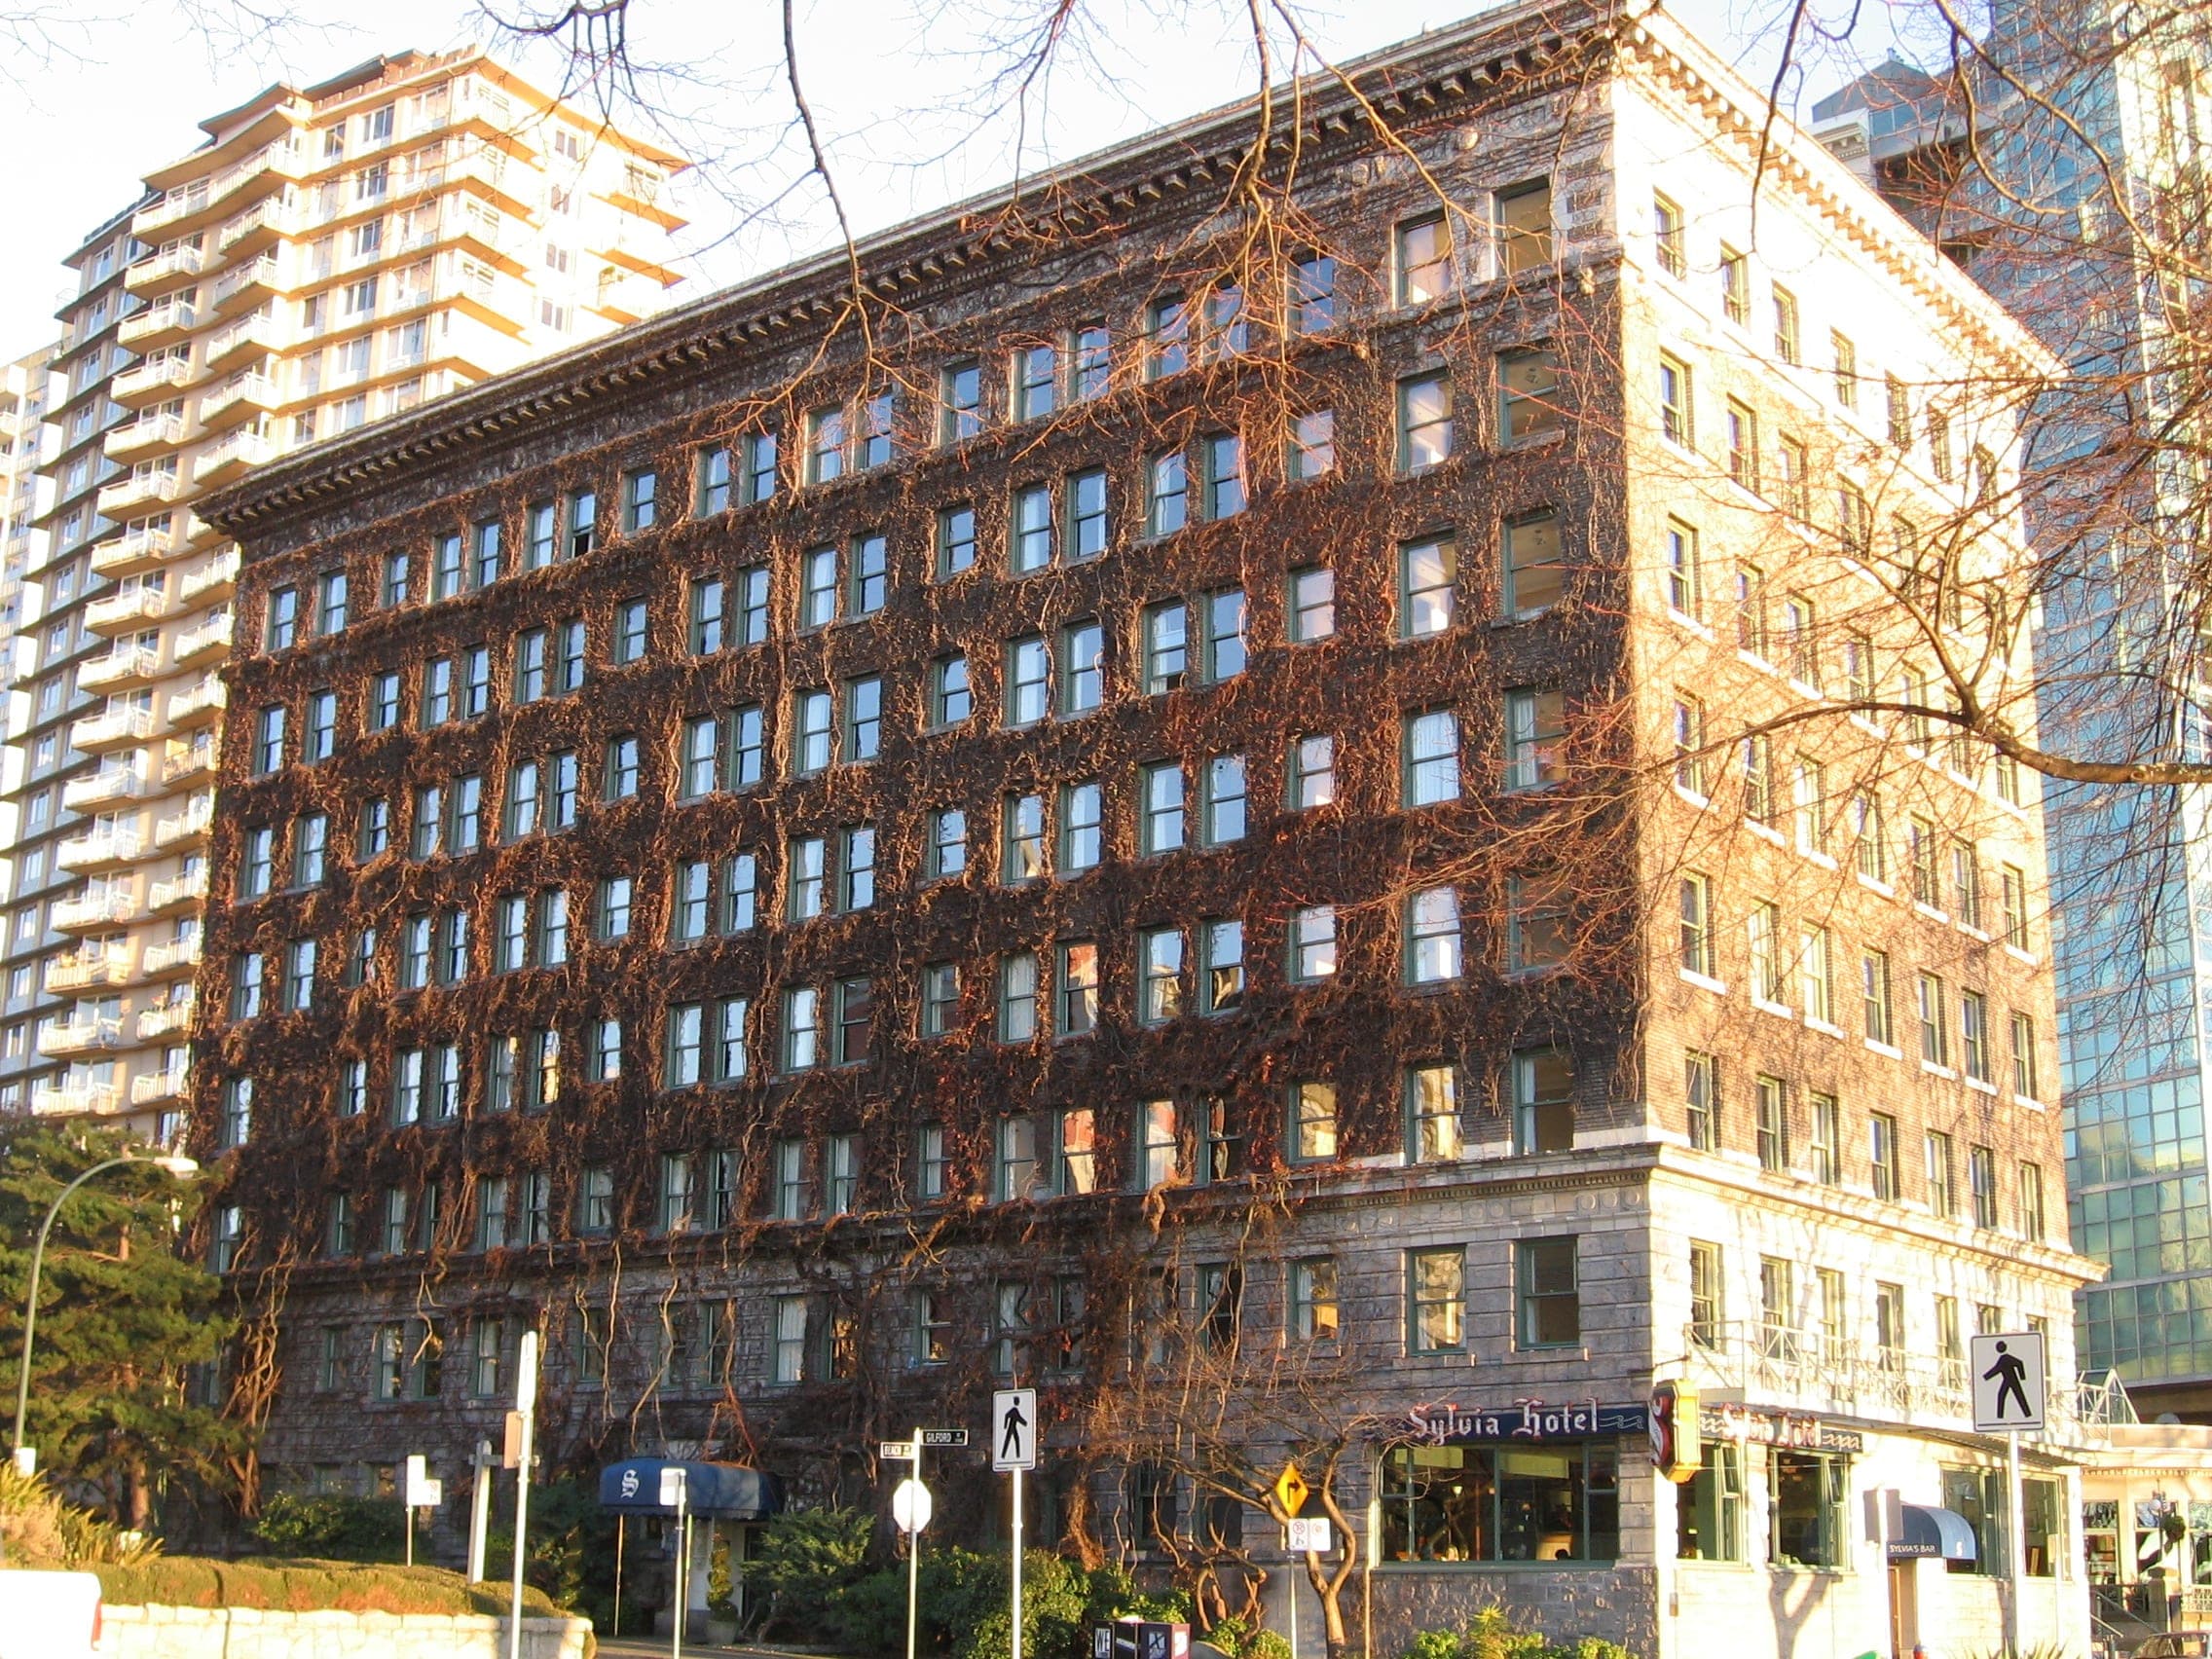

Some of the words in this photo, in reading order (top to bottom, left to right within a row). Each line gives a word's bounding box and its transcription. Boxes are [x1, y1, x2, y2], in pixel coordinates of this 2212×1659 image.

[1410, 1403, 1499, 1445] Sylvia
[1512, 1397, 1599, 1440] Hotel
[926, 1432, 952, 1443] GILFORD
[1889, 1544, 1920, 1554] SYLVIA'S
[1921, 1545, 1936, 1554] BAR
